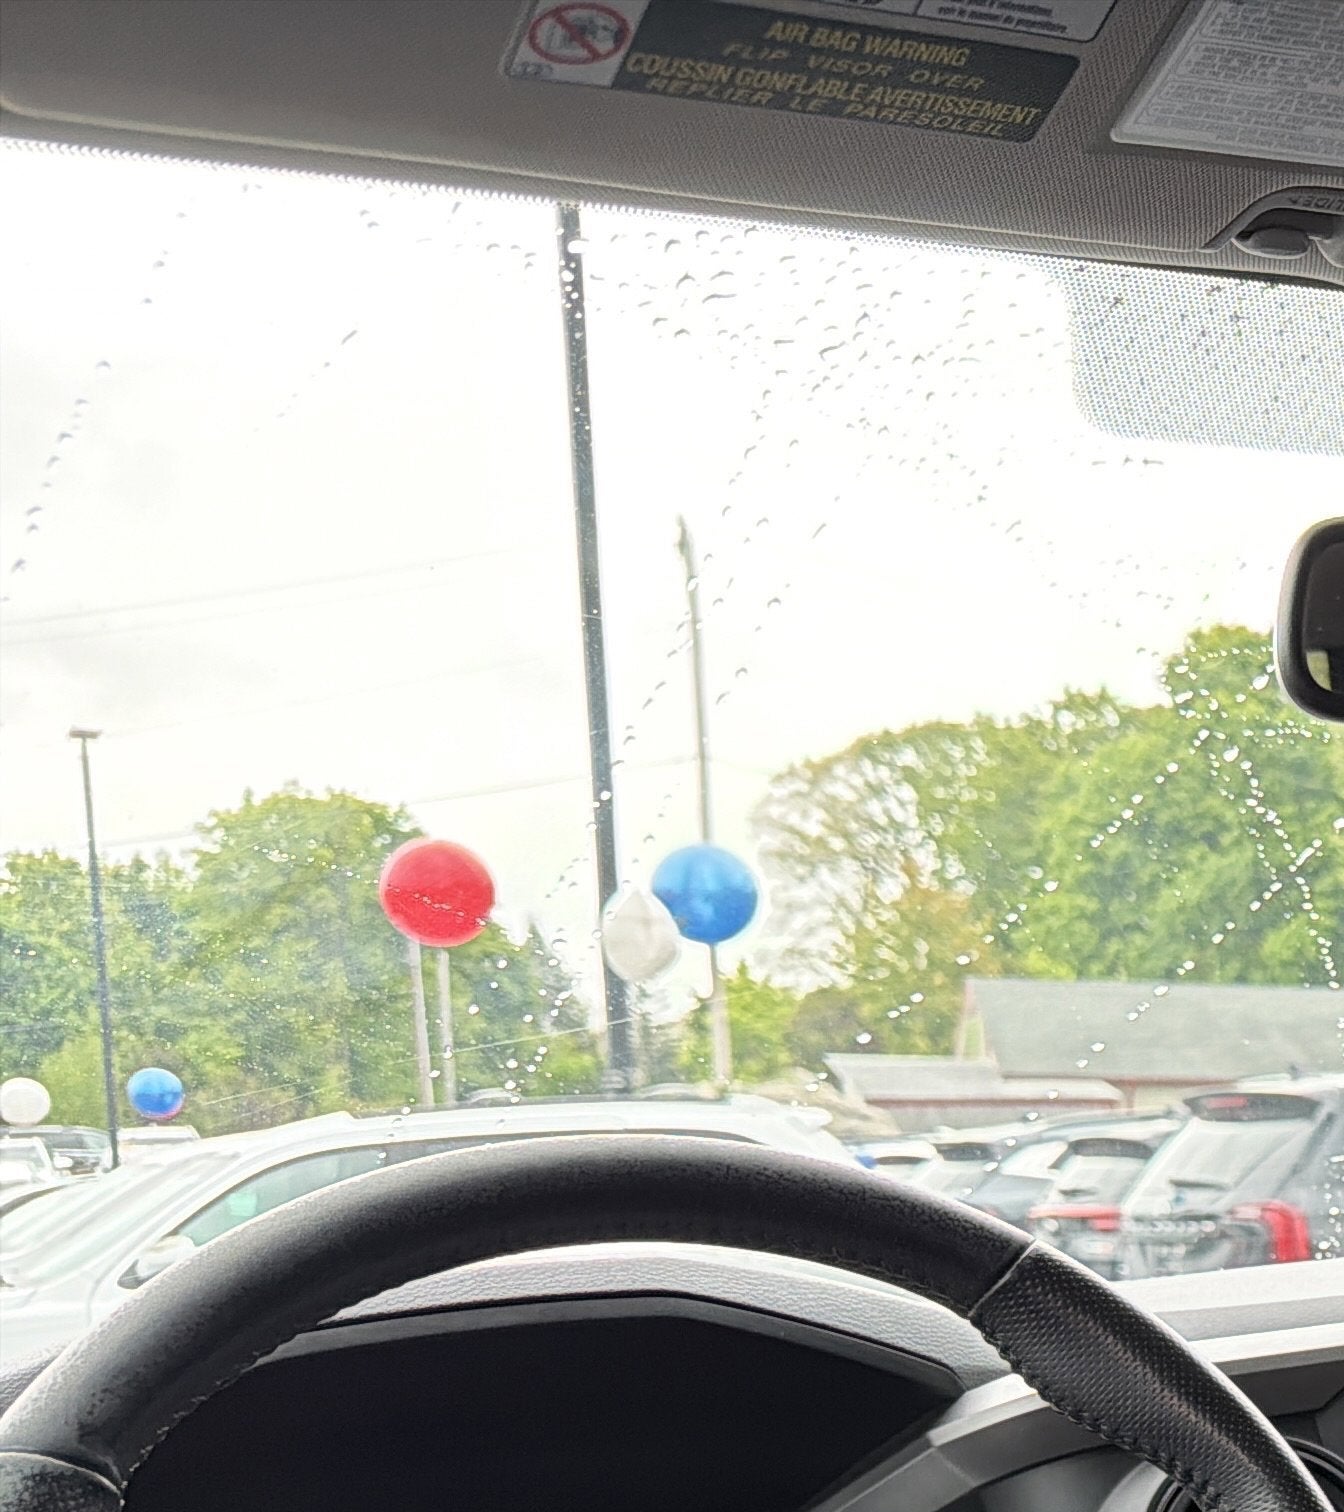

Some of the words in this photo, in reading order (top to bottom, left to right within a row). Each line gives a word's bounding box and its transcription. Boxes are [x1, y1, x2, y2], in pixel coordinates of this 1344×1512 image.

[722, 41, 792, 61] FLIP
[805, 54, 893, 78] VISOR
[907, 70, 986, 93] OVER
[764, 20, 808, 42] AIR
[808, 28, 858, 53] BAG
[860, 36, 971, 67] WARNING
[624, 53, 735, 84] COUSSIN
[734, 66, 868, 101] GONFLABLE
[868, 85, 1043, 126] AVERTISSEMENT
[644, 78, 773, 106] REPLIER
[789, 98, 827, 114] LE
[842, 103, 1006, 138] PARESOLEIL
